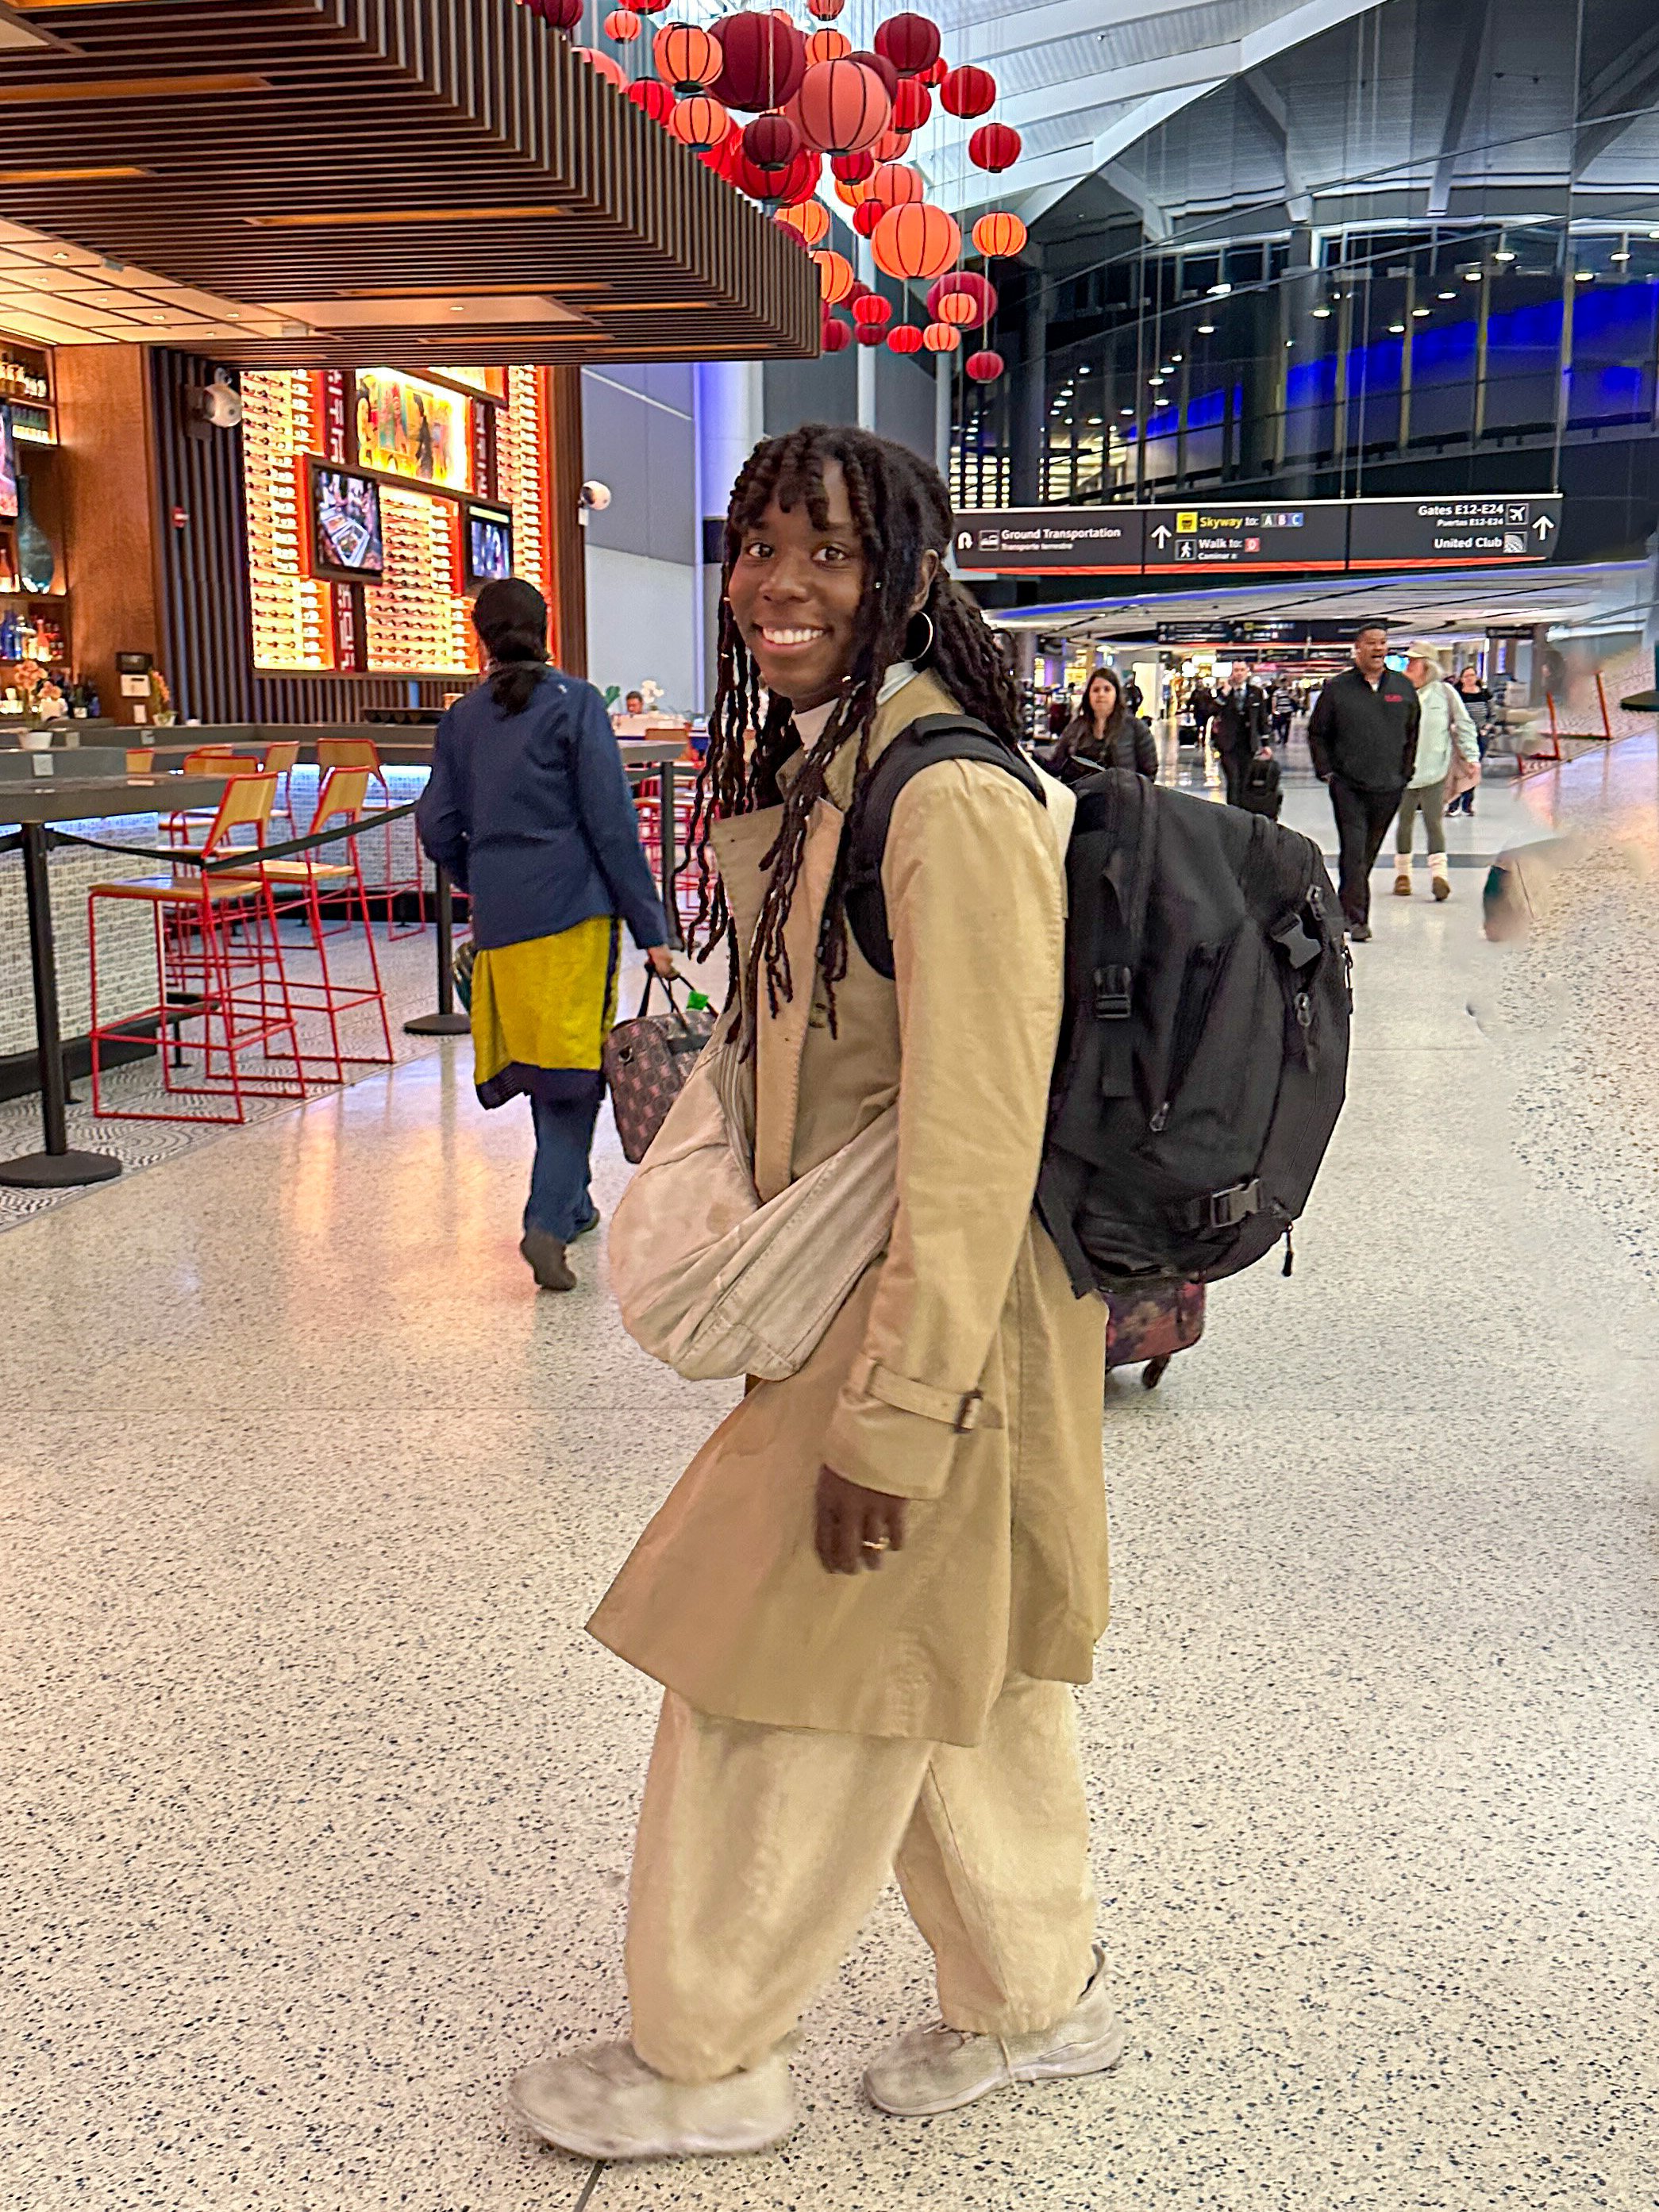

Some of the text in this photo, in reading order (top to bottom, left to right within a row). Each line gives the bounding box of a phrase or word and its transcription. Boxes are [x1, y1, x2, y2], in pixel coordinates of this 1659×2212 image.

[1418, 504, 1504, 516] Gates E12-E24
[1199, 514, 1299, 529] Skyway to: A B C
[1002, 528, 1122, 540] Ground Transportation
[1199, 538, 1227, 549] Walk
[1229, 539, 1243, 548] to:
[1434, 537, 1503, 548] United Club
